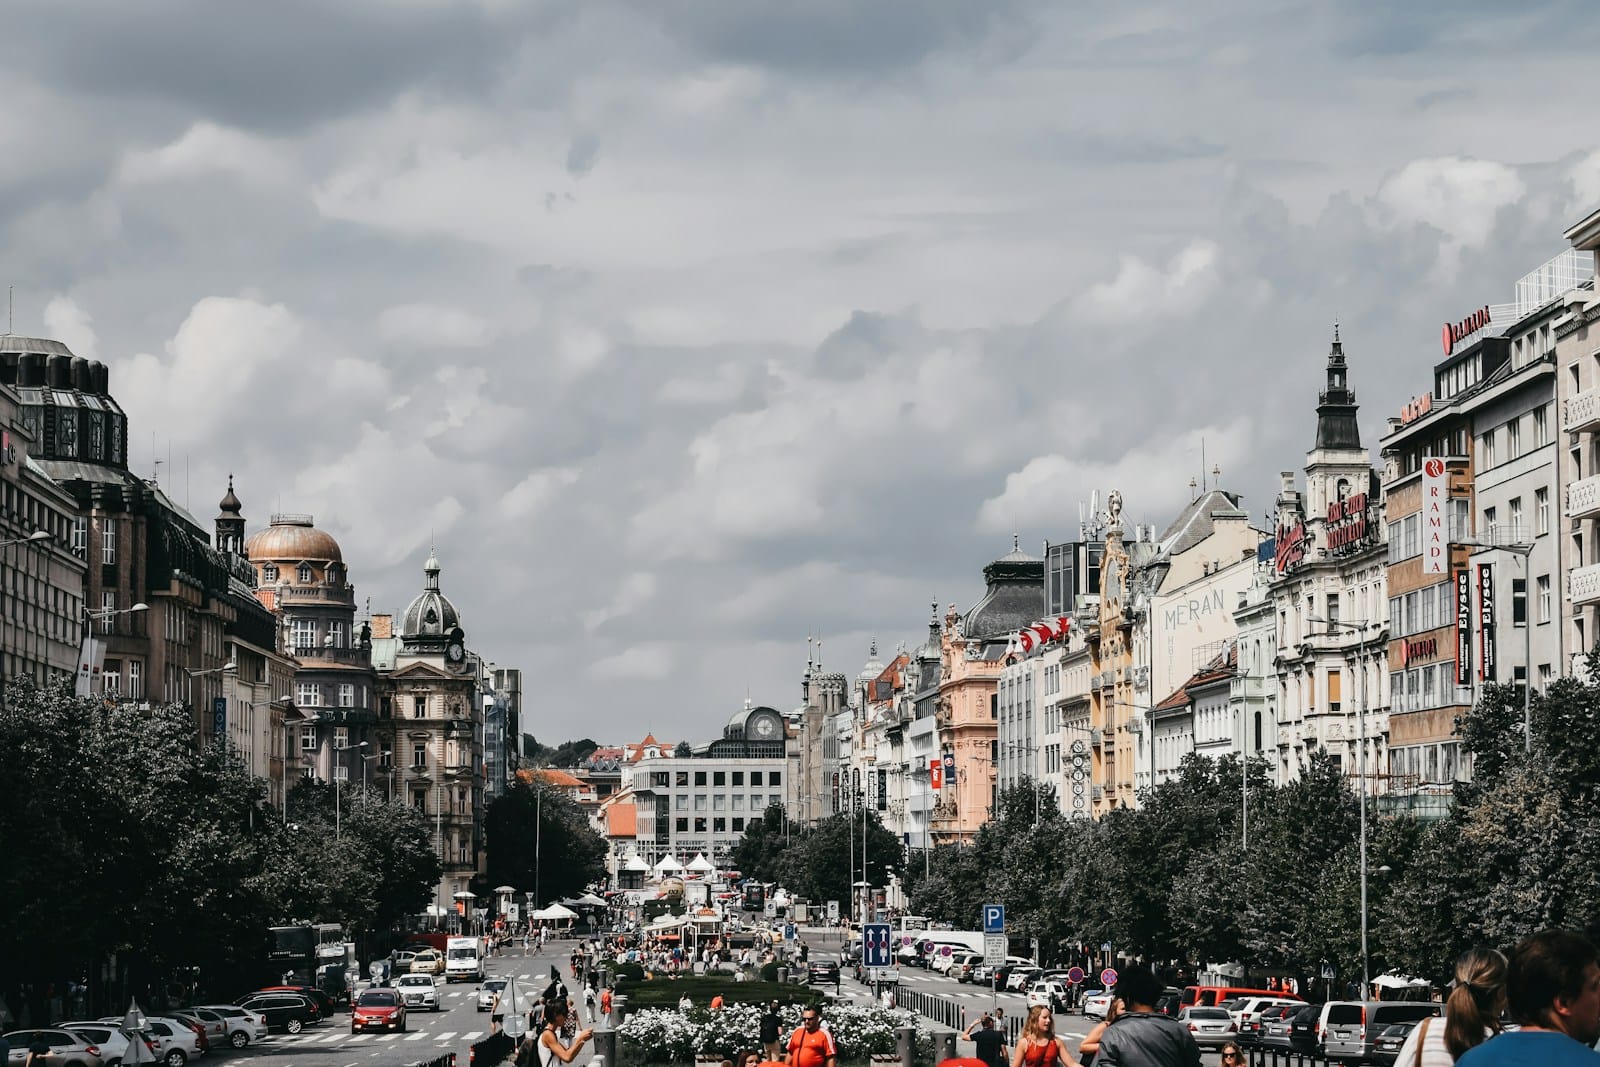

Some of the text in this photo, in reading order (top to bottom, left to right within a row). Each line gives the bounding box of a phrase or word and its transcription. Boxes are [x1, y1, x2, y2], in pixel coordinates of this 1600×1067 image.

[1429, 486, 1441, 572] RAMADA
[1165, 589, 1224, 630] MERAN
[1459, 575, 1469, 629] Elysee
[1482, 568, 1492, 624] Elysee
[988, 909, 1000, 926] P
